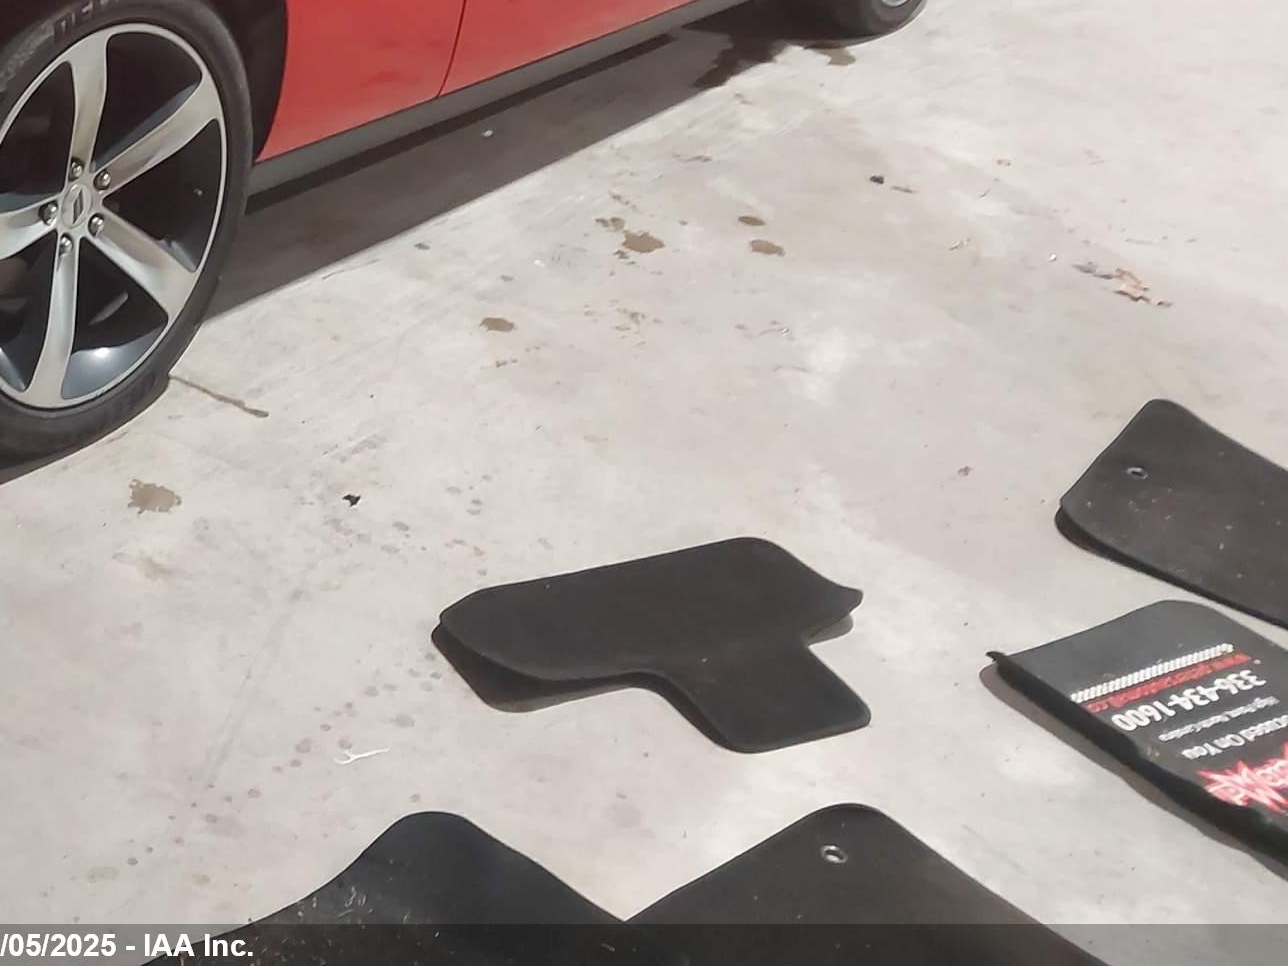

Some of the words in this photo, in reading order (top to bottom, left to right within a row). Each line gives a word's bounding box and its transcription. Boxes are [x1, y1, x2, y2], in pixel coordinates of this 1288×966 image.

[1111, 669, 1267, 731] 336-434-1600
[1213, 733, 1246, 749] On
[1181, 742, 1223, 760] You
